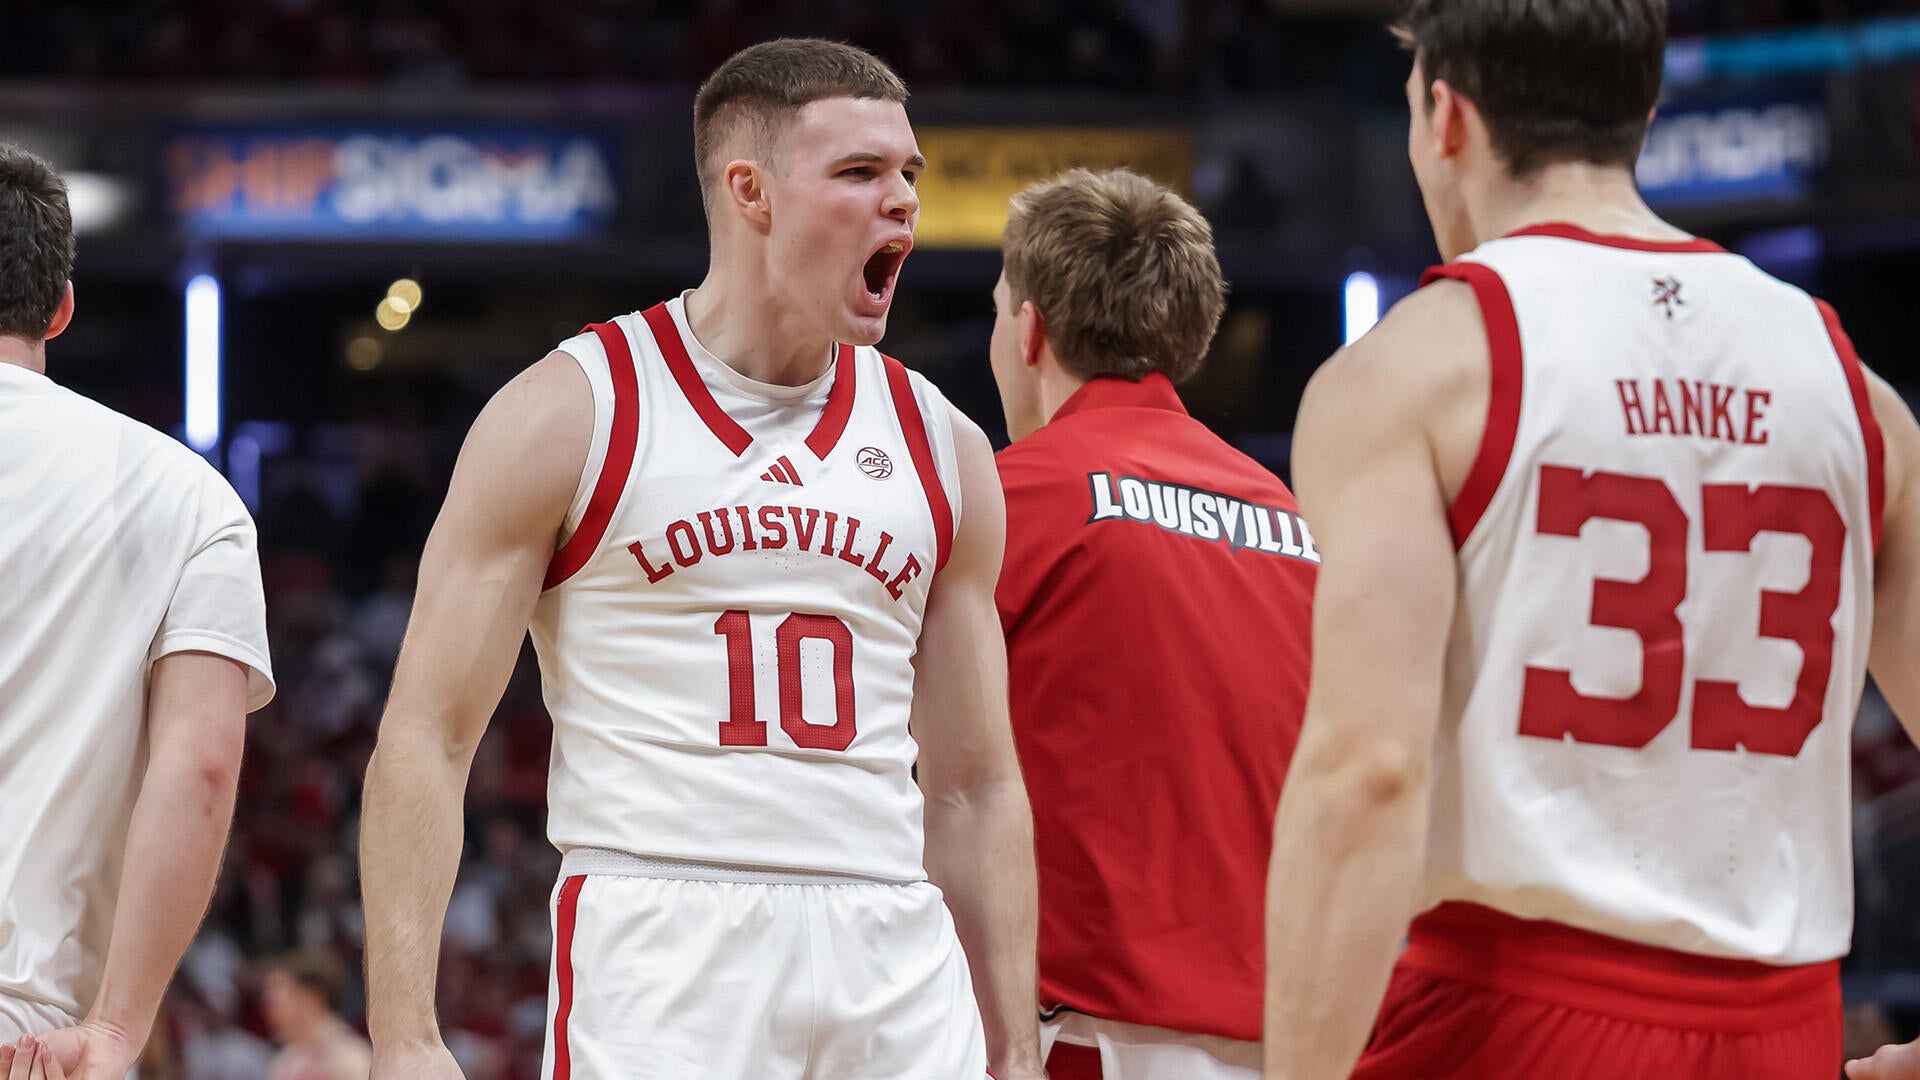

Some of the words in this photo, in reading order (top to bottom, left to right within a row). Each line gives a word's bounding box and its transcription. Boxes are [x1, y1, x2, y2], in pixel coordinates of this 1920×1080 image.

[1614, 378, 1773, 446] HANKE
[860, 456, 890, 467] ACC
[627, 505, 922, 601] LOUISVILLE
[1517, 464, 1847, 758] 33
[714, 609, 857, 751] 10
